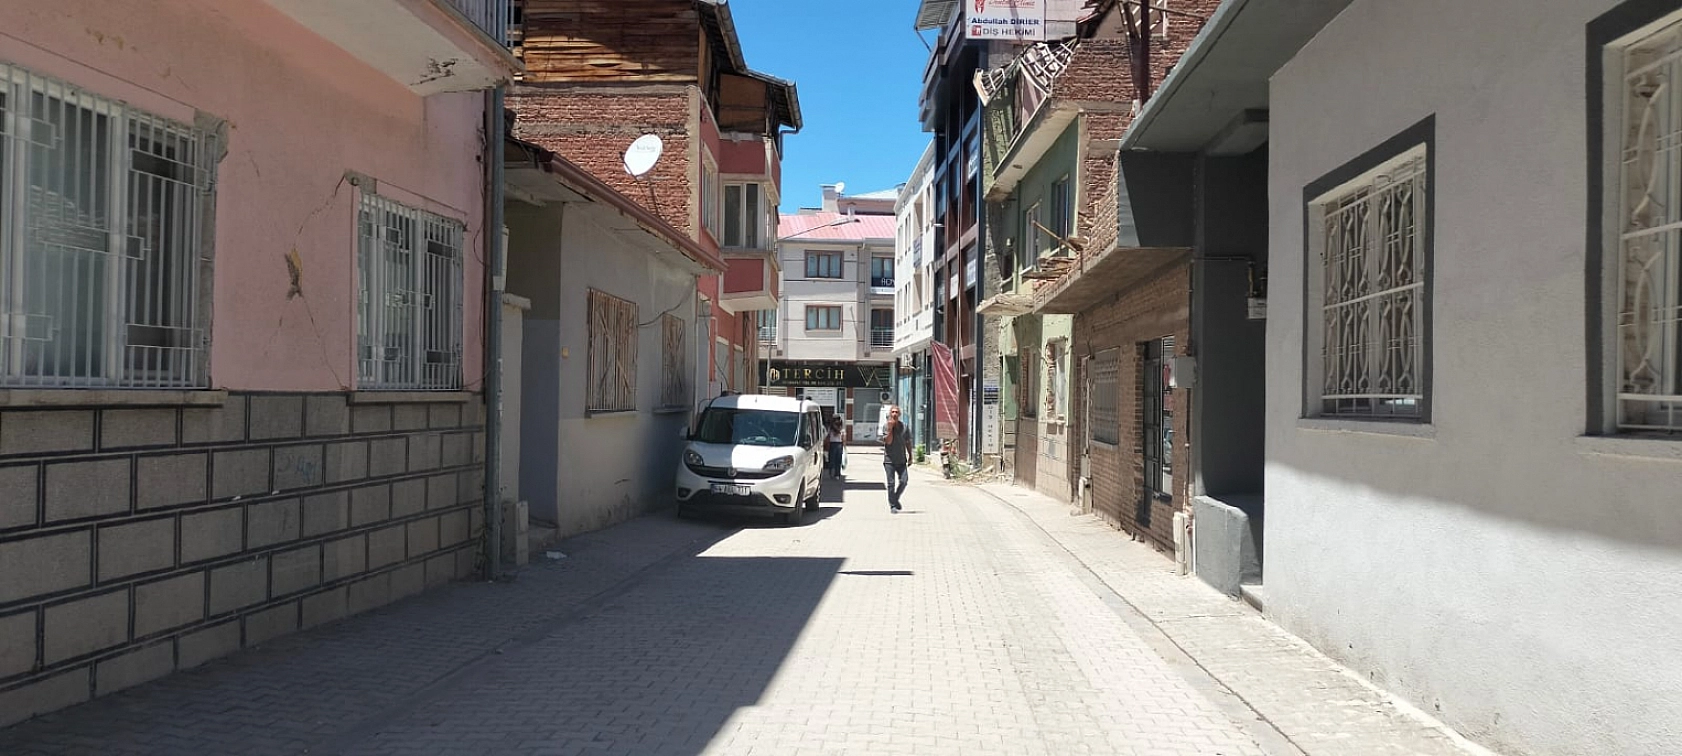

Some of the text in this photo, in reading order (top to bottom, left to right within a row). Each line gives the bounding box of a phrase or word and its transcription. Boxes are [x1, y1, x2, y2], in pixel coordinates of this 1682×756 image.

[971, 17, 1008, 25] Abdullah
[983, 27, 1036, 36] DİŞ HEKİMİ
[782, 367, 844, 379] TERCİH
